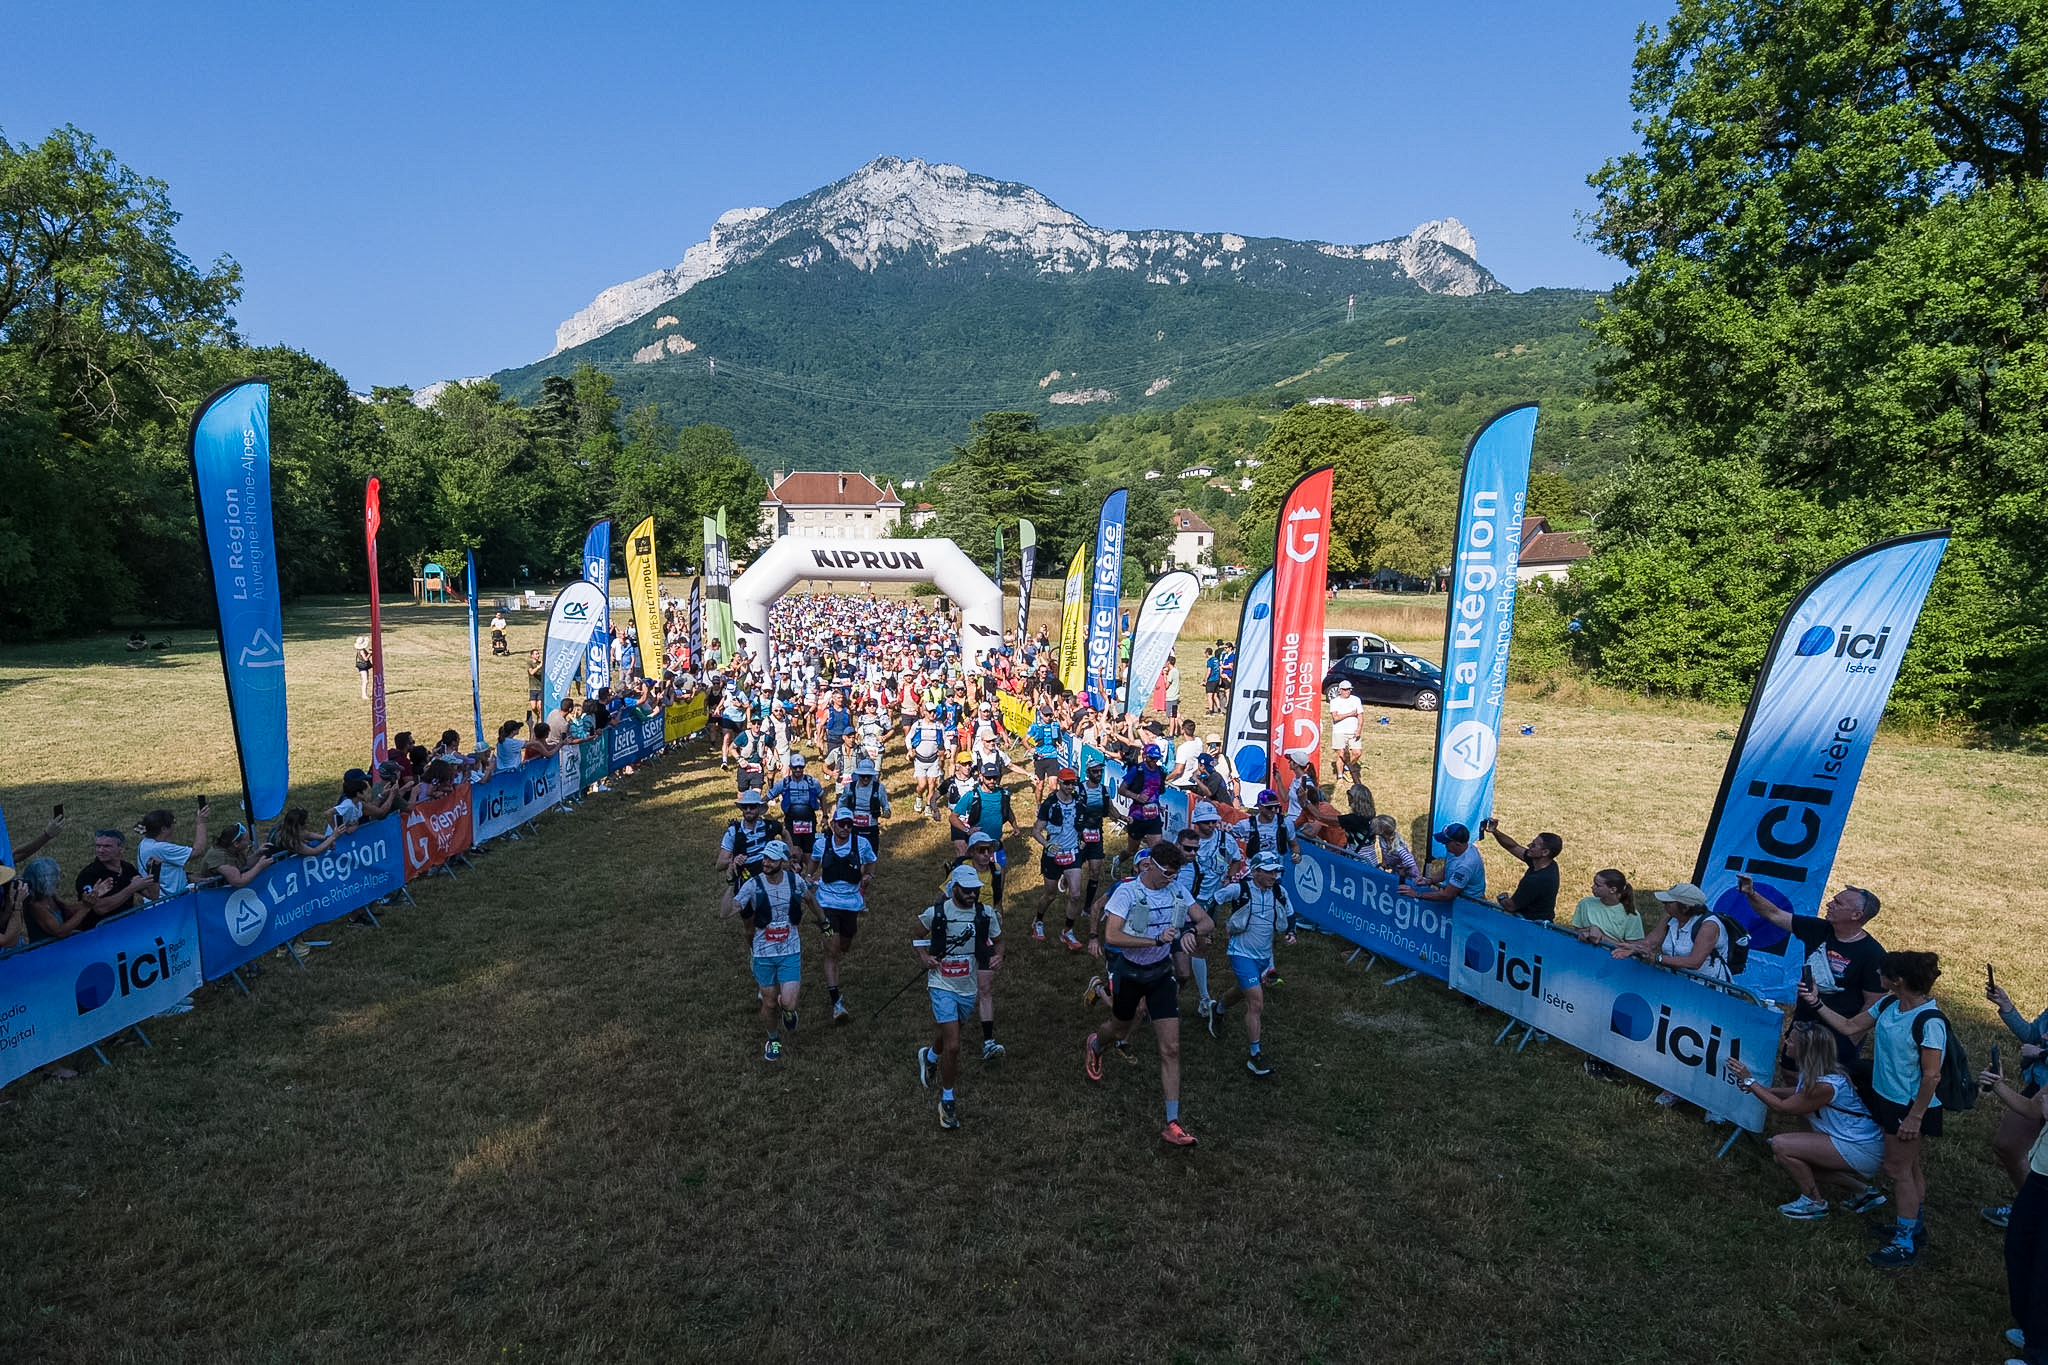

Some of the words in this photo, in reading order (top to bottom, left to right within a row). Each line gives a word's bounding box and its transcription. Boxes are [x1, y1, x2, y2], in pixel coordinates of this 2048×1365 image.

[224, 488, 246, 569] Région
[240, 429, 263, 600] Auvergne-Rhône-Alpes
[233, 574, 248, 600] La
[811, 549, 925, 570] KIPRUN
[1094, 525, 1116, 592] isère
[1455, 490, 1498, 649] Région
[1486, 491, 1525, 707] Auvergne-Rhône-Alpes
[1835, 625, 1892, 660] ici
[1845, 661, 1877, 674] Isère
[551, 649, 578, 701] AGRICOLE
[1281, 632, 1300, 715] Grenoble
[1295, 662, 1317, 712] Alpes
[1447, 658, 1476, 710] La
[1813, 715, 1858, 781] Isère
[487, 790, 504, 821] ici
[1726, 780, 1833, 883] ici
[267, 872, 299, 905] La
[302, 838, 387, 888] Région
[1330, 863, 1356, 901] La
[1362, 876, 1453, 940] Région
[168, 937, 186, 953] Radio
[1328, 901, 1450, 968] Auvergne-Rhône-Alpe
[117, 936, 170, 997] ici
[1496, 940, 1542, 999] ici
[0, 1003, 27, 1023] adio
[1543, 987, 1575, 1014] Isère
[0, 1024, 36, 1050] Digital
[1656, 1003, 1722, 1078] ici
